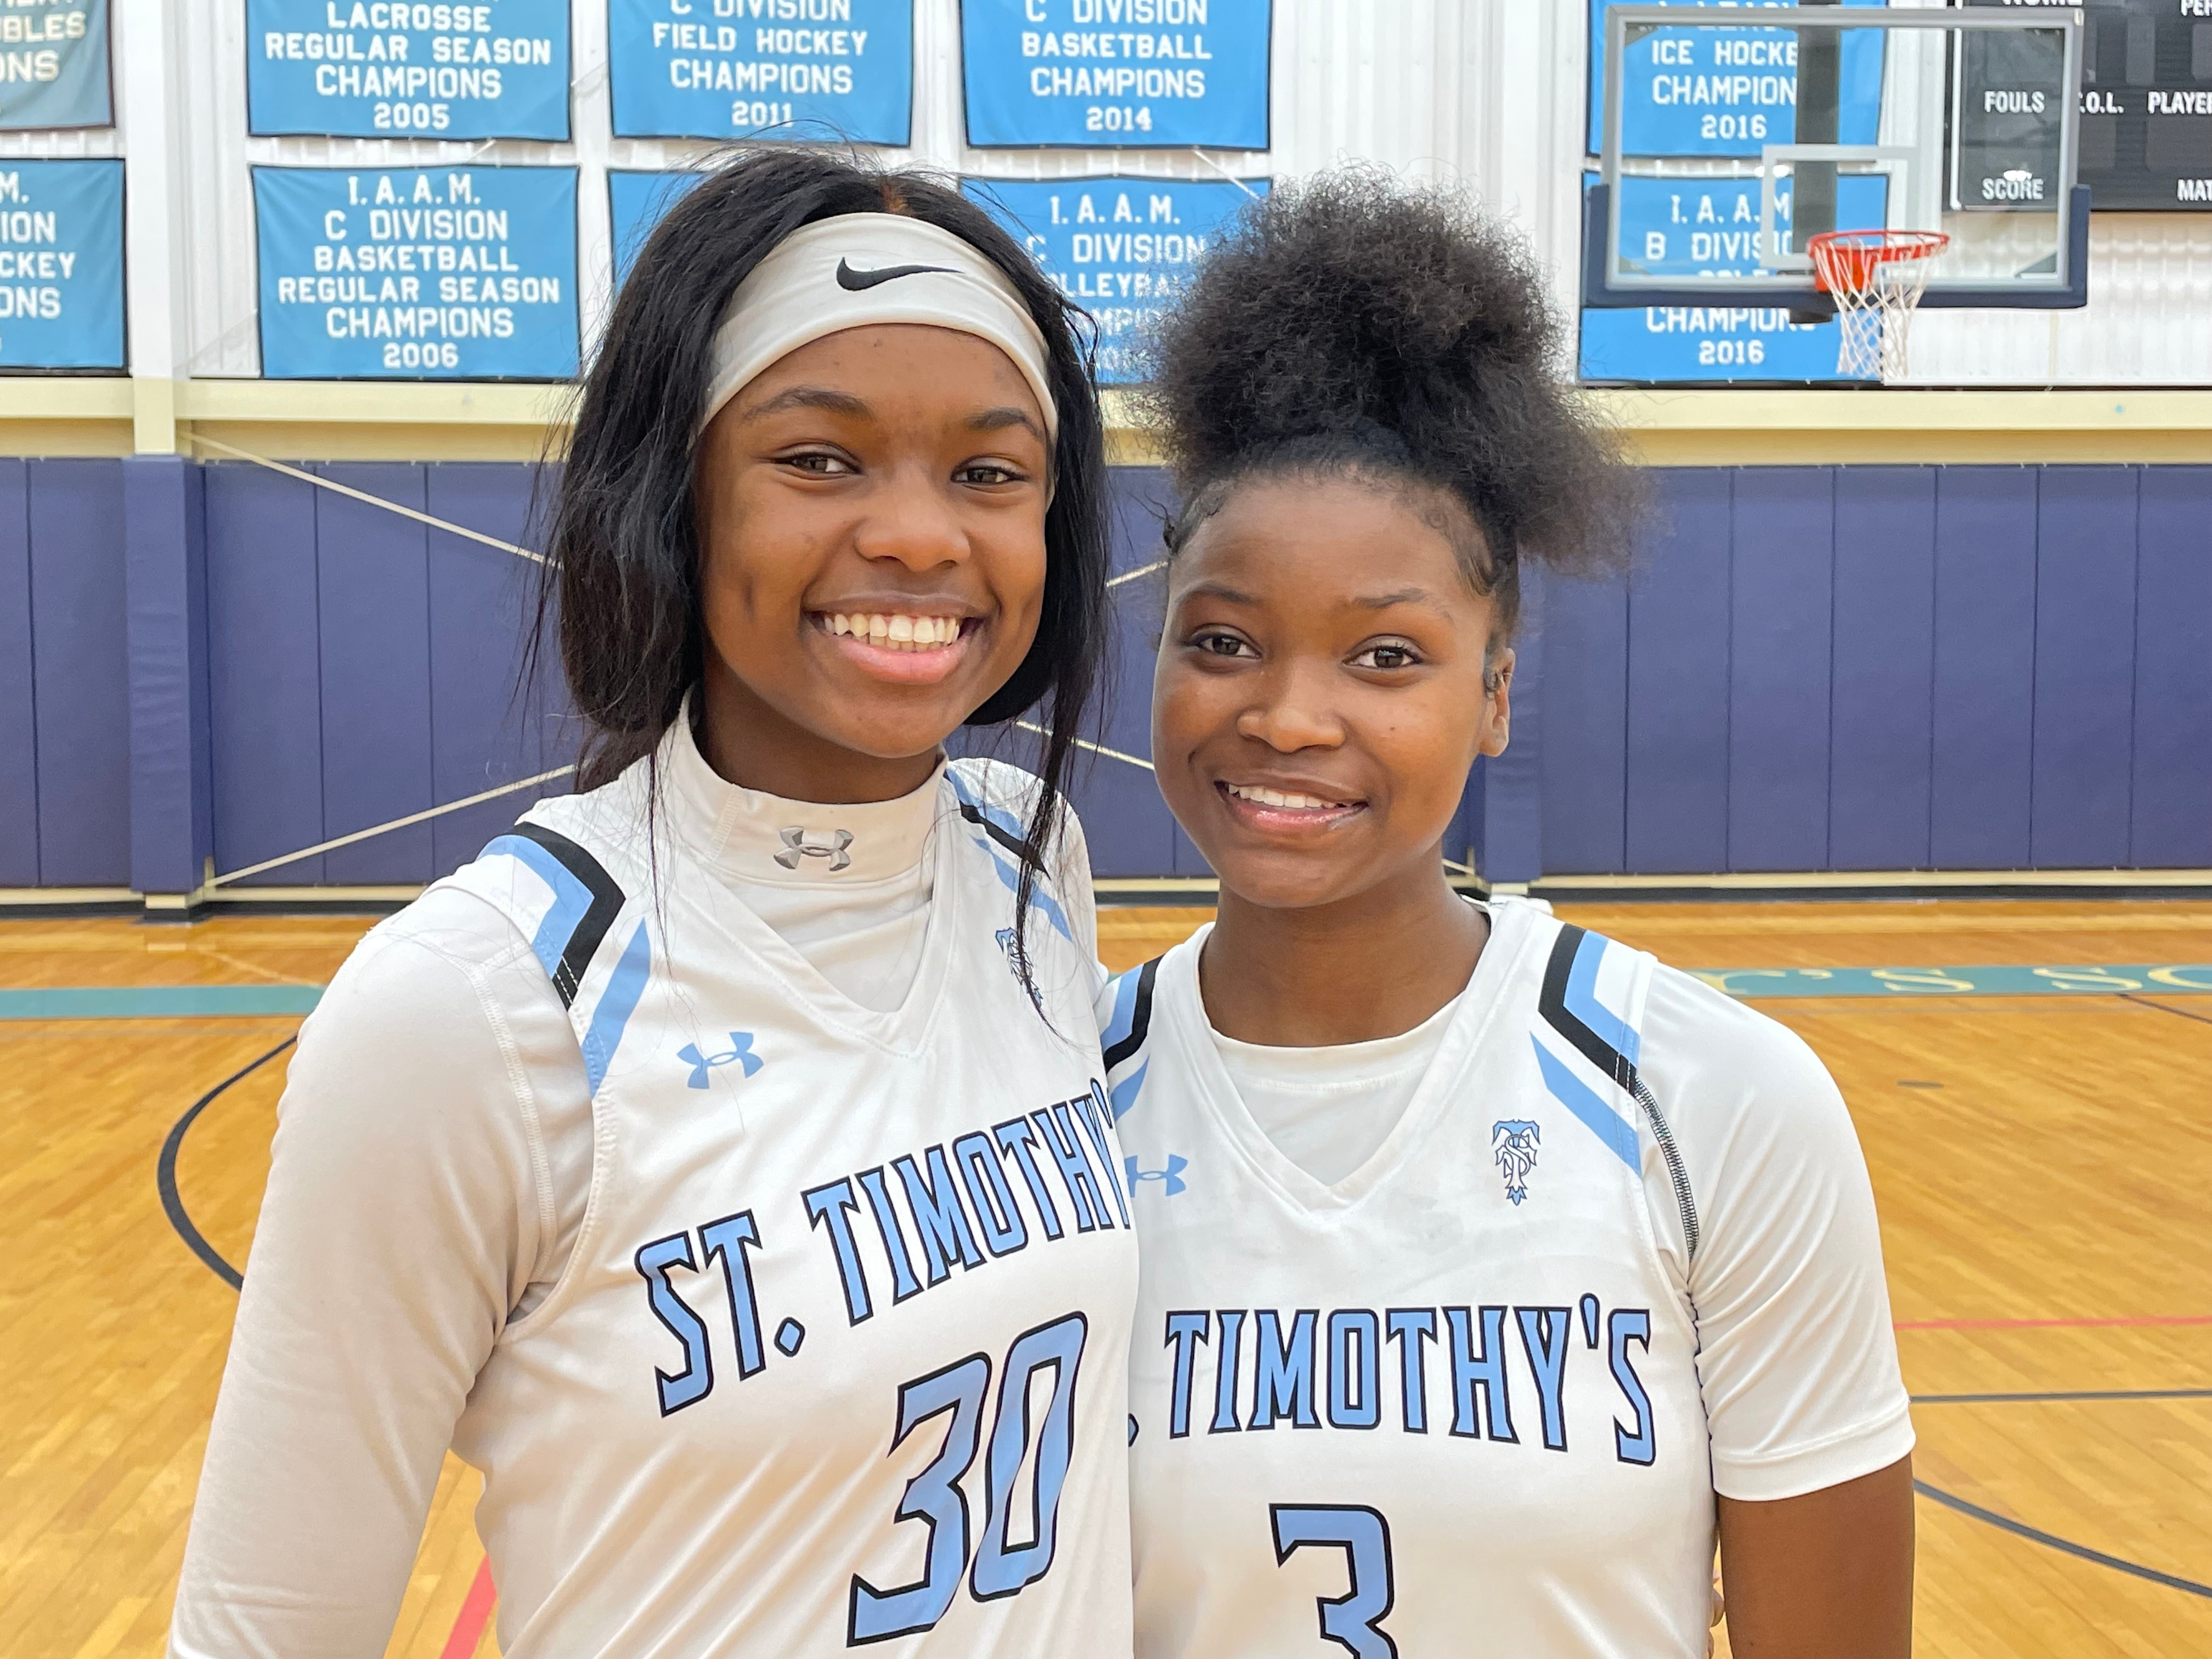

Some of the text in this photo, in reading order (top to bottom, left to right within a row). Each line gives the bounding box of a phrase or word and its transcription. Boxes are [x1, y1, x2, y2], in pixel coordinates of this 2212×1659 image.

[327, 2, 491, 32] LACROSSE
[714, 0, 850, 21] DIVISION
[1025, 0, 1207, 25] C DIVISION
[265, 33, 551, 65] REGULAR SEASON
[653, 22, 867, 55] FIELD HOCKEY
[1022, 32, 1212, 59] BASKETBALL
[1652, 40, 1798, 66] ICE HOCKE
[315, 65, 501, 99] CHAMPIONS
[670, 59, 853, 94] CHAMPIONS
[1031, 67, 1205, 98] CHAMPIONS
[1652, 75, 1797, 106] CHAMPION
[1984, 91, 2045, 113] FOULS
[2078, 91, 2124, 114] .O.L.
[374, 103, 450, 129] 2005
[732, 100, 794, 127] 2011
[1086, 106, 1152, 131] 2014
[1701, 114, 1767, 139] 2016
[1982, 178, 2044, 200] SCORE
[325, 210, 507, 240] C DIVISION
[314, 246, 519, 272] BASKETBALL
[1073, 233, 1206, 264] DIVISION
[1646, 232, 1666, 261] B
[278, 276, 560, 303] REGULAR SEASON
[326, 307, 514, 338] CHAMPIONS
[1646, 307, 1815, 332] CHAMPION
[383, 343, 459, 368] 2006
[1699, 340, 1764, 364] 2016
[635, 1077, 1131, 1418] ST. TIMOTHY'
[1164, 1293, 1656, 1467] TIMOTHY'S
[847, 1310, 1088, 1648] 30
[1269, 1503, 1398, 1659] 3
